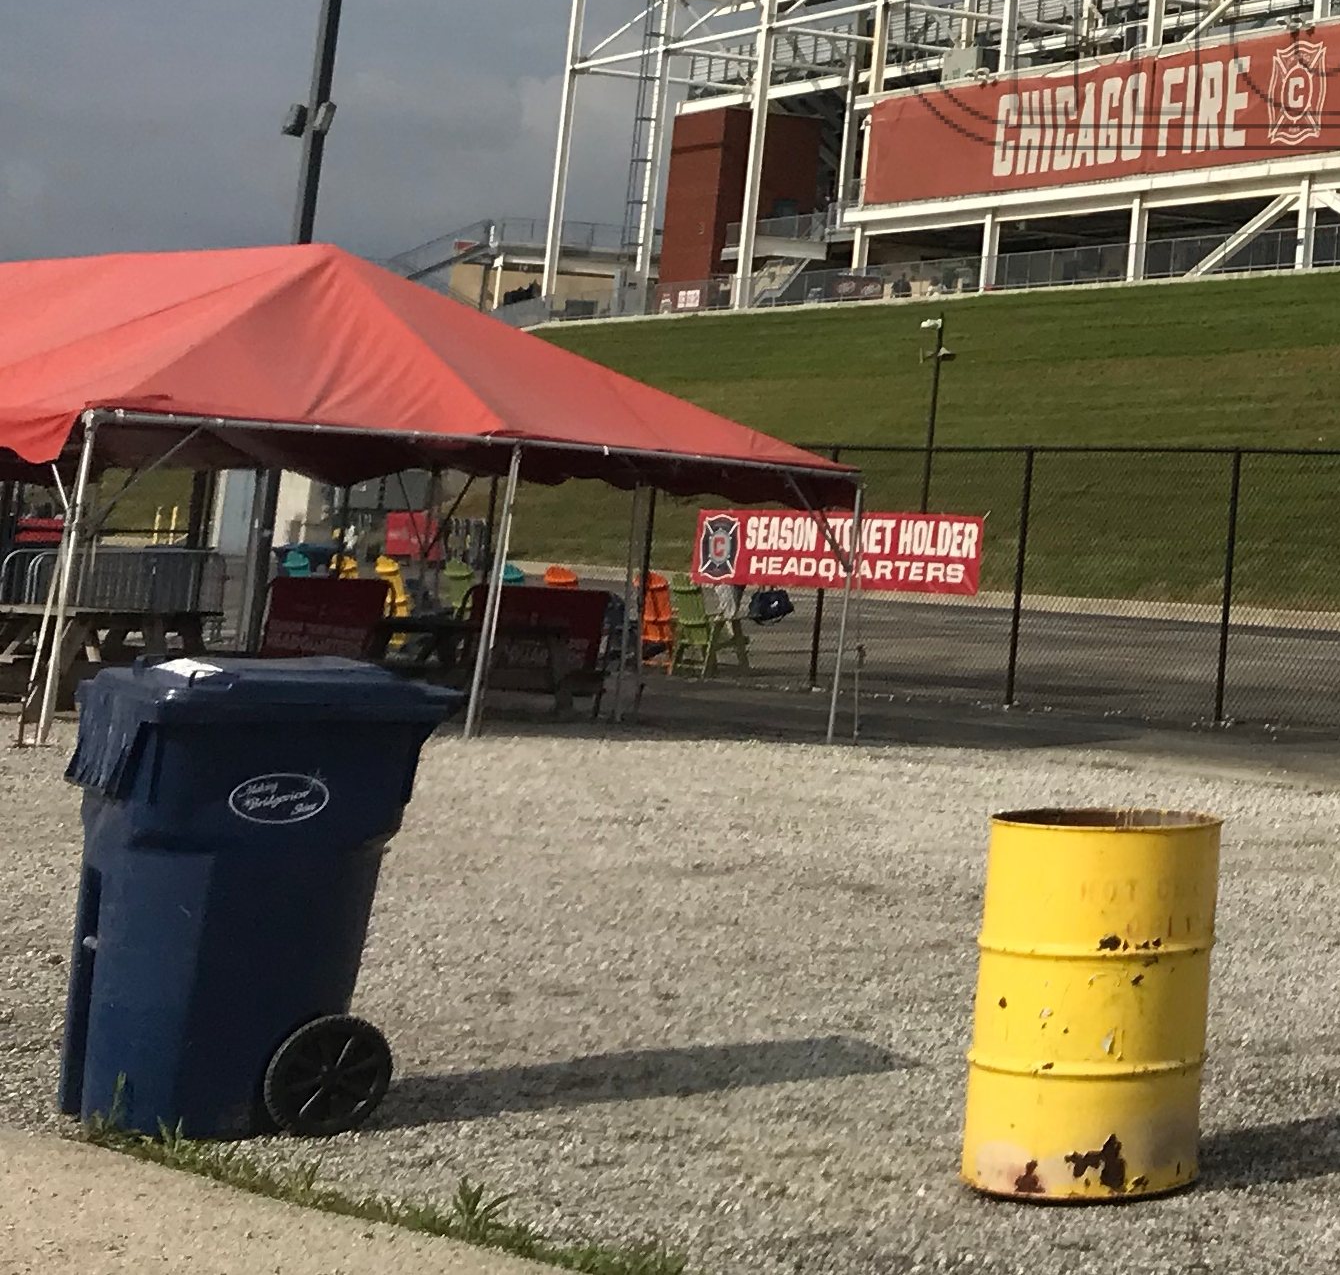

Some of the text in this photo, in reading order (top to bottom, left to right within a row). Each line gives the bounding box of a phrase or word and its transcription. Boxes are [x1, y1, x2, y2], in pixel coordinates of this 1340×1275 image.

[993, 71, 1148, 177] CHICAGO
[1156, 55, 1252, 158] FIRE
[745, 516, 818, 552] SEASON
[897, 519, 978, 559] HOLDER
[749, 556, 966, 584] HEADQUARTERS
